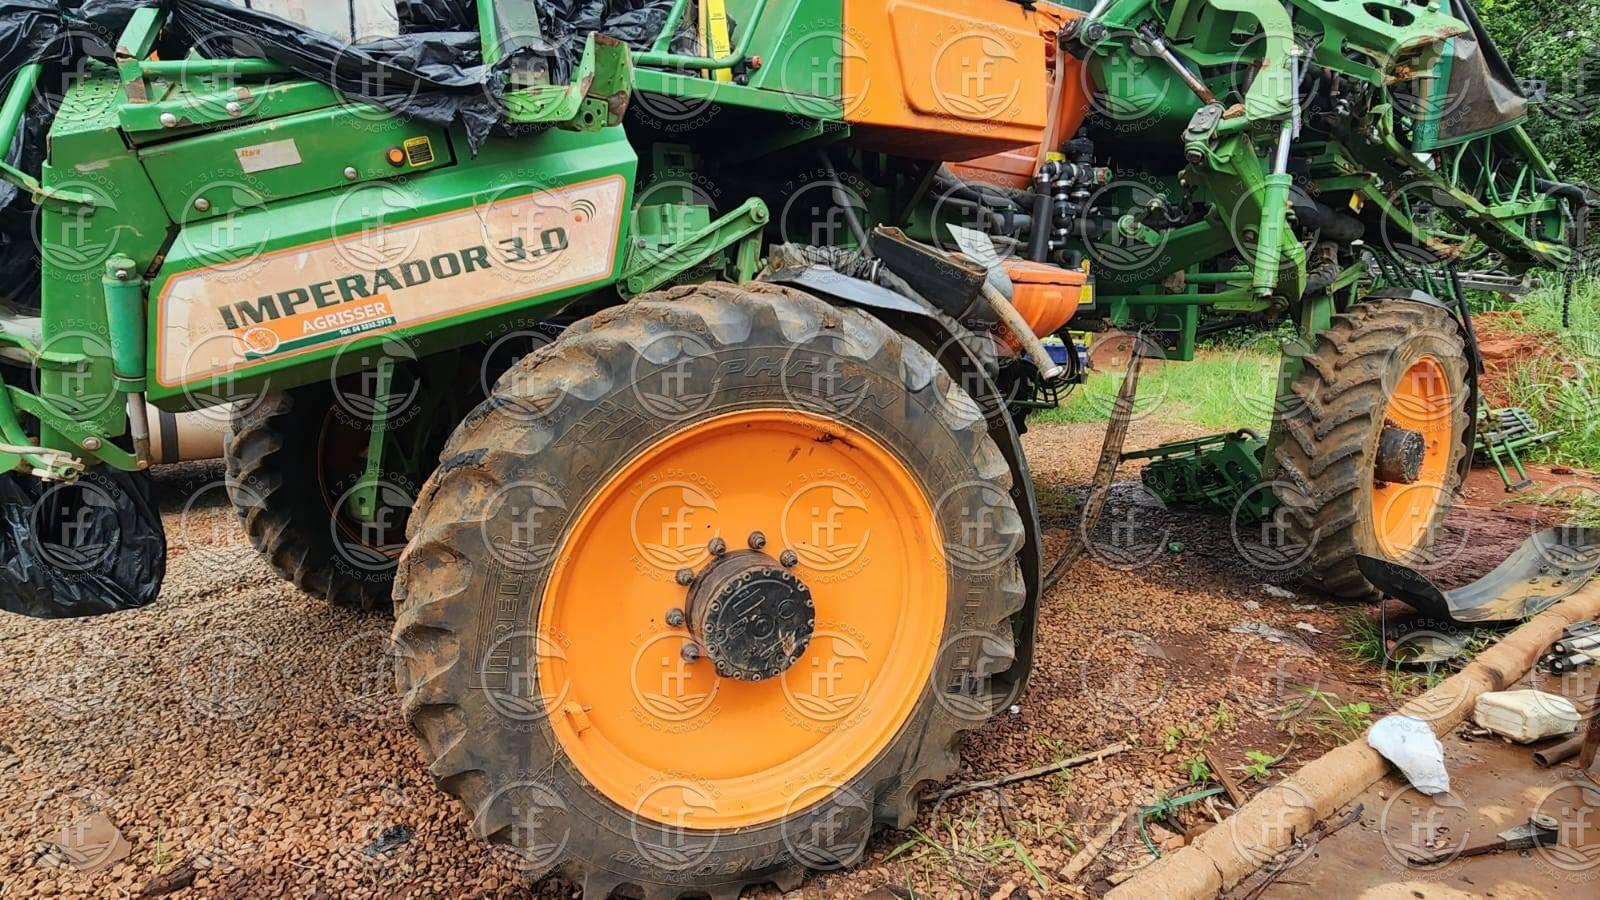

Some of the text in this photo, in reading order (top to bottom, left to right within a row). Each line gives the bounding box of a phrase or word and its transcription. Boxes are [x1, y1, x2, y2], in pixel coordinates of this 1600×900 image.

[218, 226, 569, 330] IMPERADOR 3.0
[302, 301, 388, 333] AGRISSER
